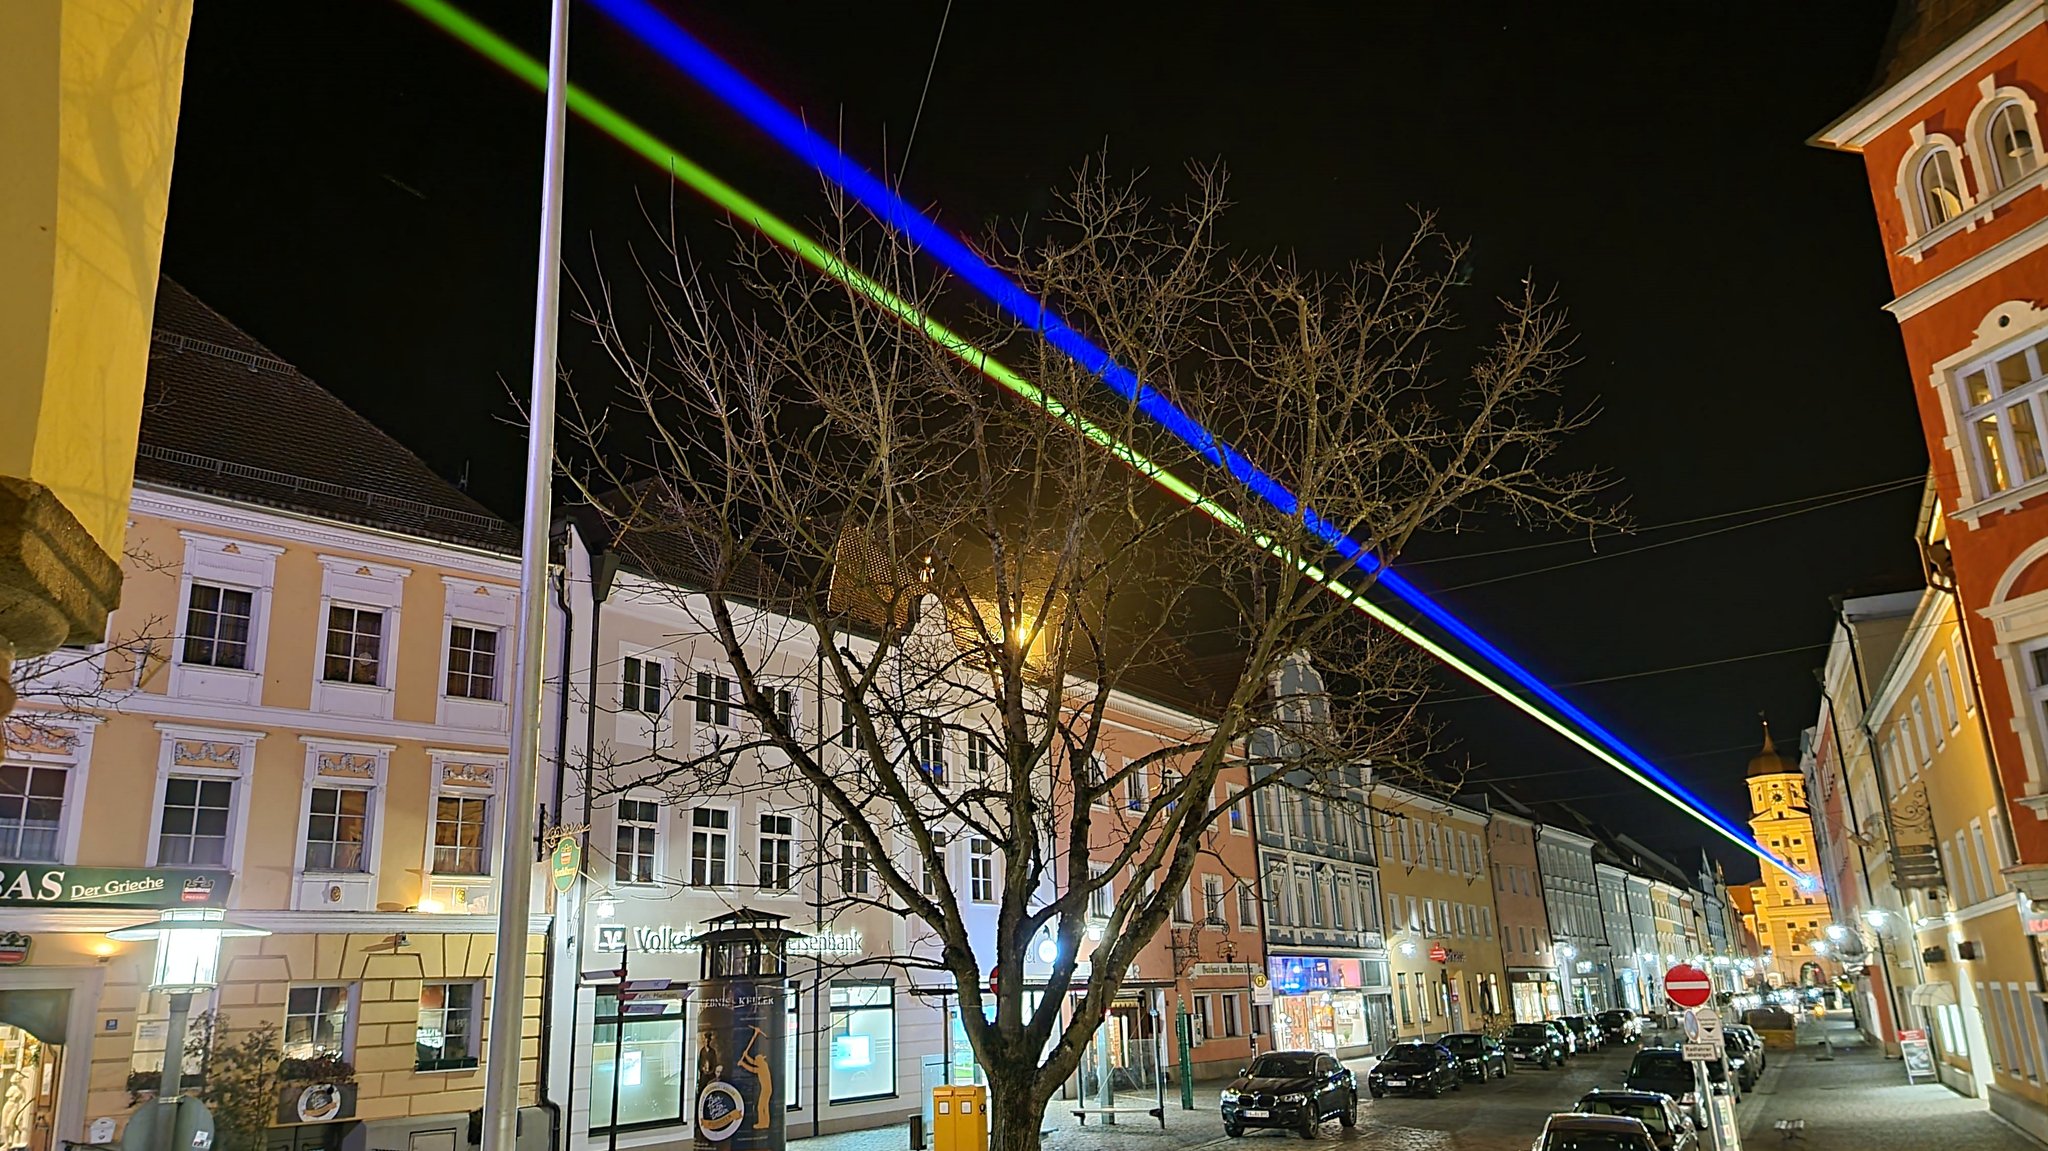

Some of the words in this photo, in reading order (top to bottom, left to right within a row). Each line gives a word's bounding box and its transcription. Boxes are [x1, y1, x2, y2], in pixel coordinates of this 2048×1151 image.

[71, 884, 100, 898] Der
[104, 876, 165, 894] Grieche
[787, 929, 863, 951] eisenbank
